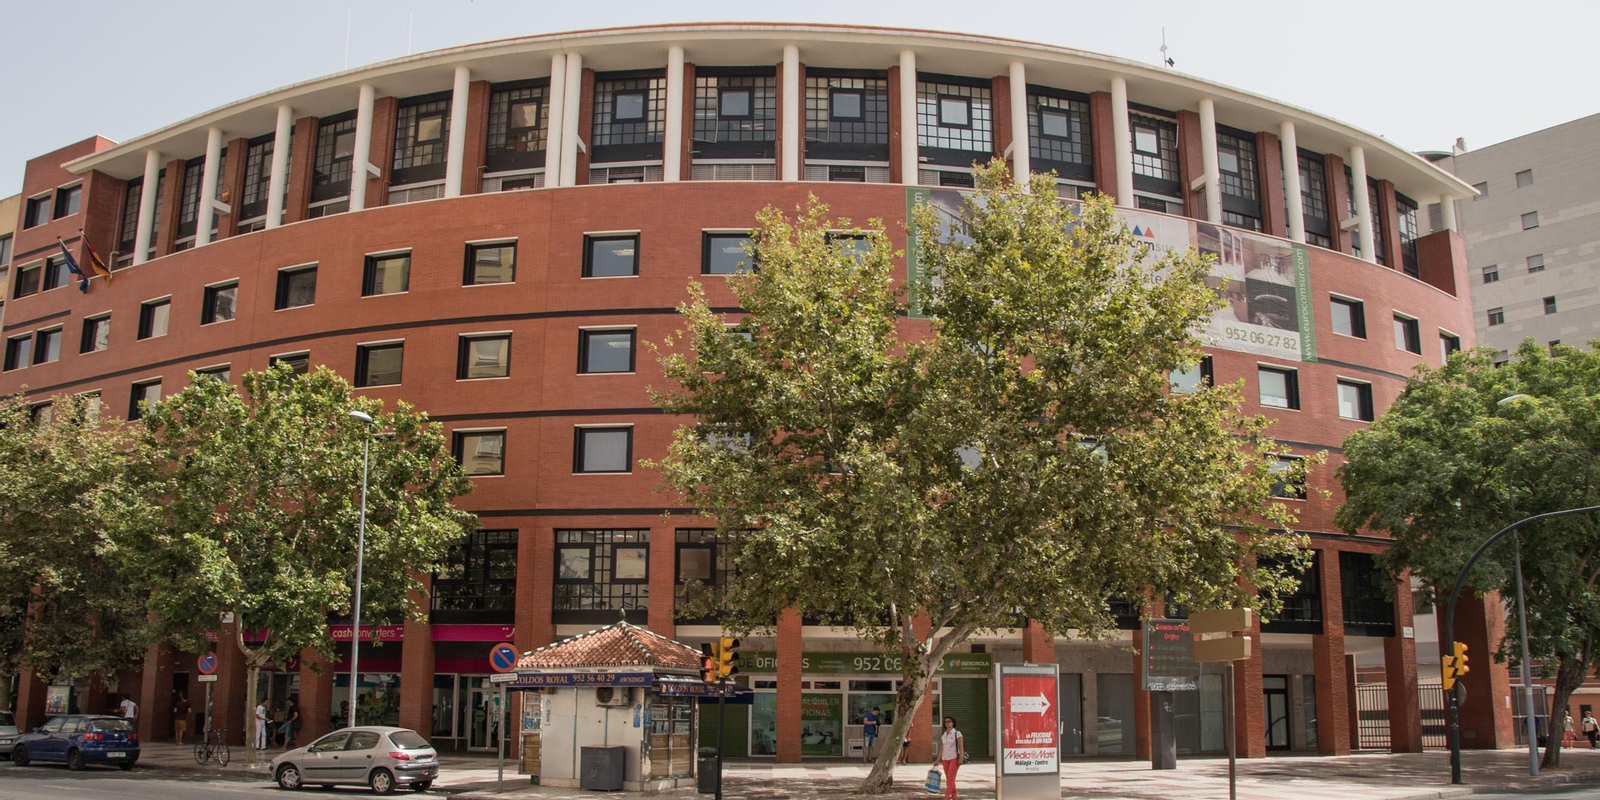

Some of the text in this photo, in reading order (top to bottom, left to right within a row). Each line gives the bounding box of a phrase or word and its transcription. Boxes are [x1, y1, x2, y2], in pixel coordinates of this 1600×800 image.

[1296, 248, 1312, 359] www.eurocomsur.com
[1225, 327, 1297, 350] 952 06 27 82
[854, 657, 880, 671] 952
[546, 676, 569, 684] ROYAL
[572, 674, 585, 682] 952
[586, 674, 595, 682] 56
[596, 674, 605, 682] 40
[606, 674, 615, 682] 29
[802, 709, 832, 717] FICINAS
[1005, 750, 1055, 759] Media Markt
